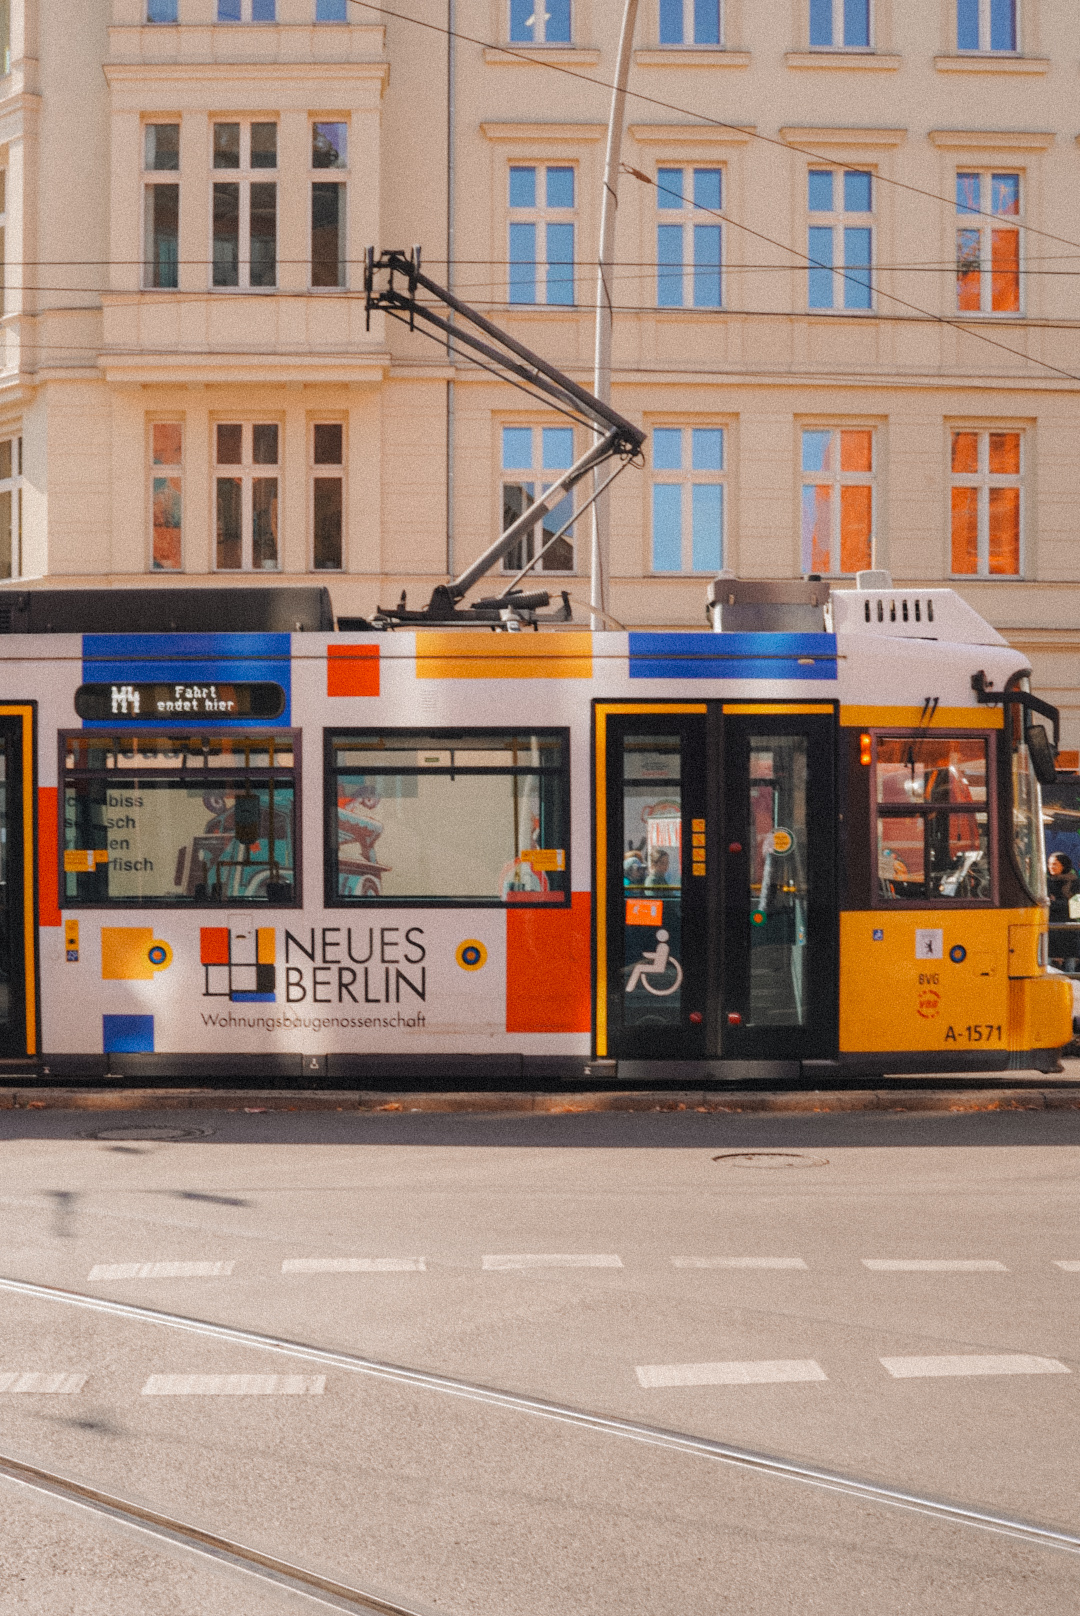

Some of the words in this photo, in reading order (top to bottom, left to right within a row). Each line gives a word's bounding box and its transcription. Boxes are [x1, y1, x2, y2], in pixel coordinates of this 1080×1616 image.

[174, 686, 217, 699] Fahrt
[157, 699, 199, 711] endet
[205, 699, 235, 711] hier
[285, 927, 426, 964] NEUES
[286, 966, 426, 1003] BERLIN
[918, 973, 940, 985] BVG
[201, 1011, 426, 1032] Wohnungsbaugenossenschaft
[945, 1024, 1002, 1042] A-1571
